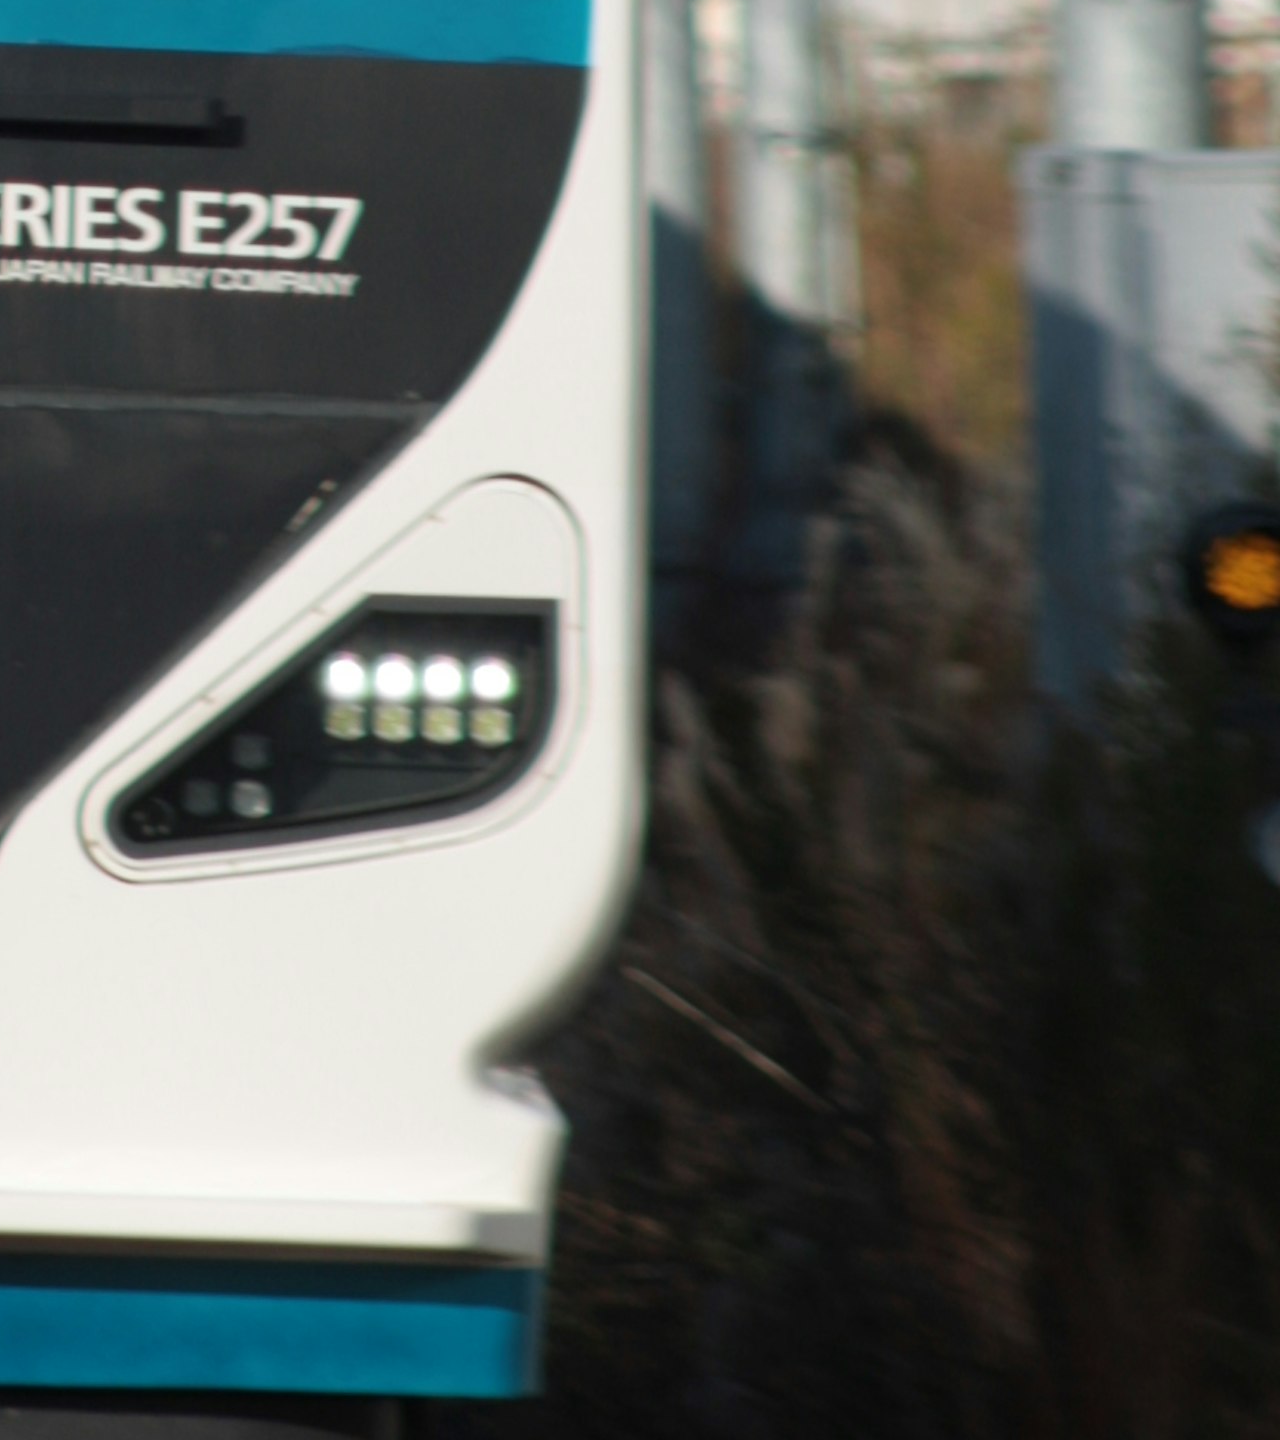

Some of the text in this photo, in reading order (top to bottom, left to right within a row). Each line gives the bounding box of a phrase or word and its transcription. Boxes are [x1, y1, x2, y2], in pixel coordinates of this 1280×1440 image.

[178, 190, 364, 261] E257
[89, 262, 211, 290] RAILWAY
[211, 266, 360, 297] COMPANY
